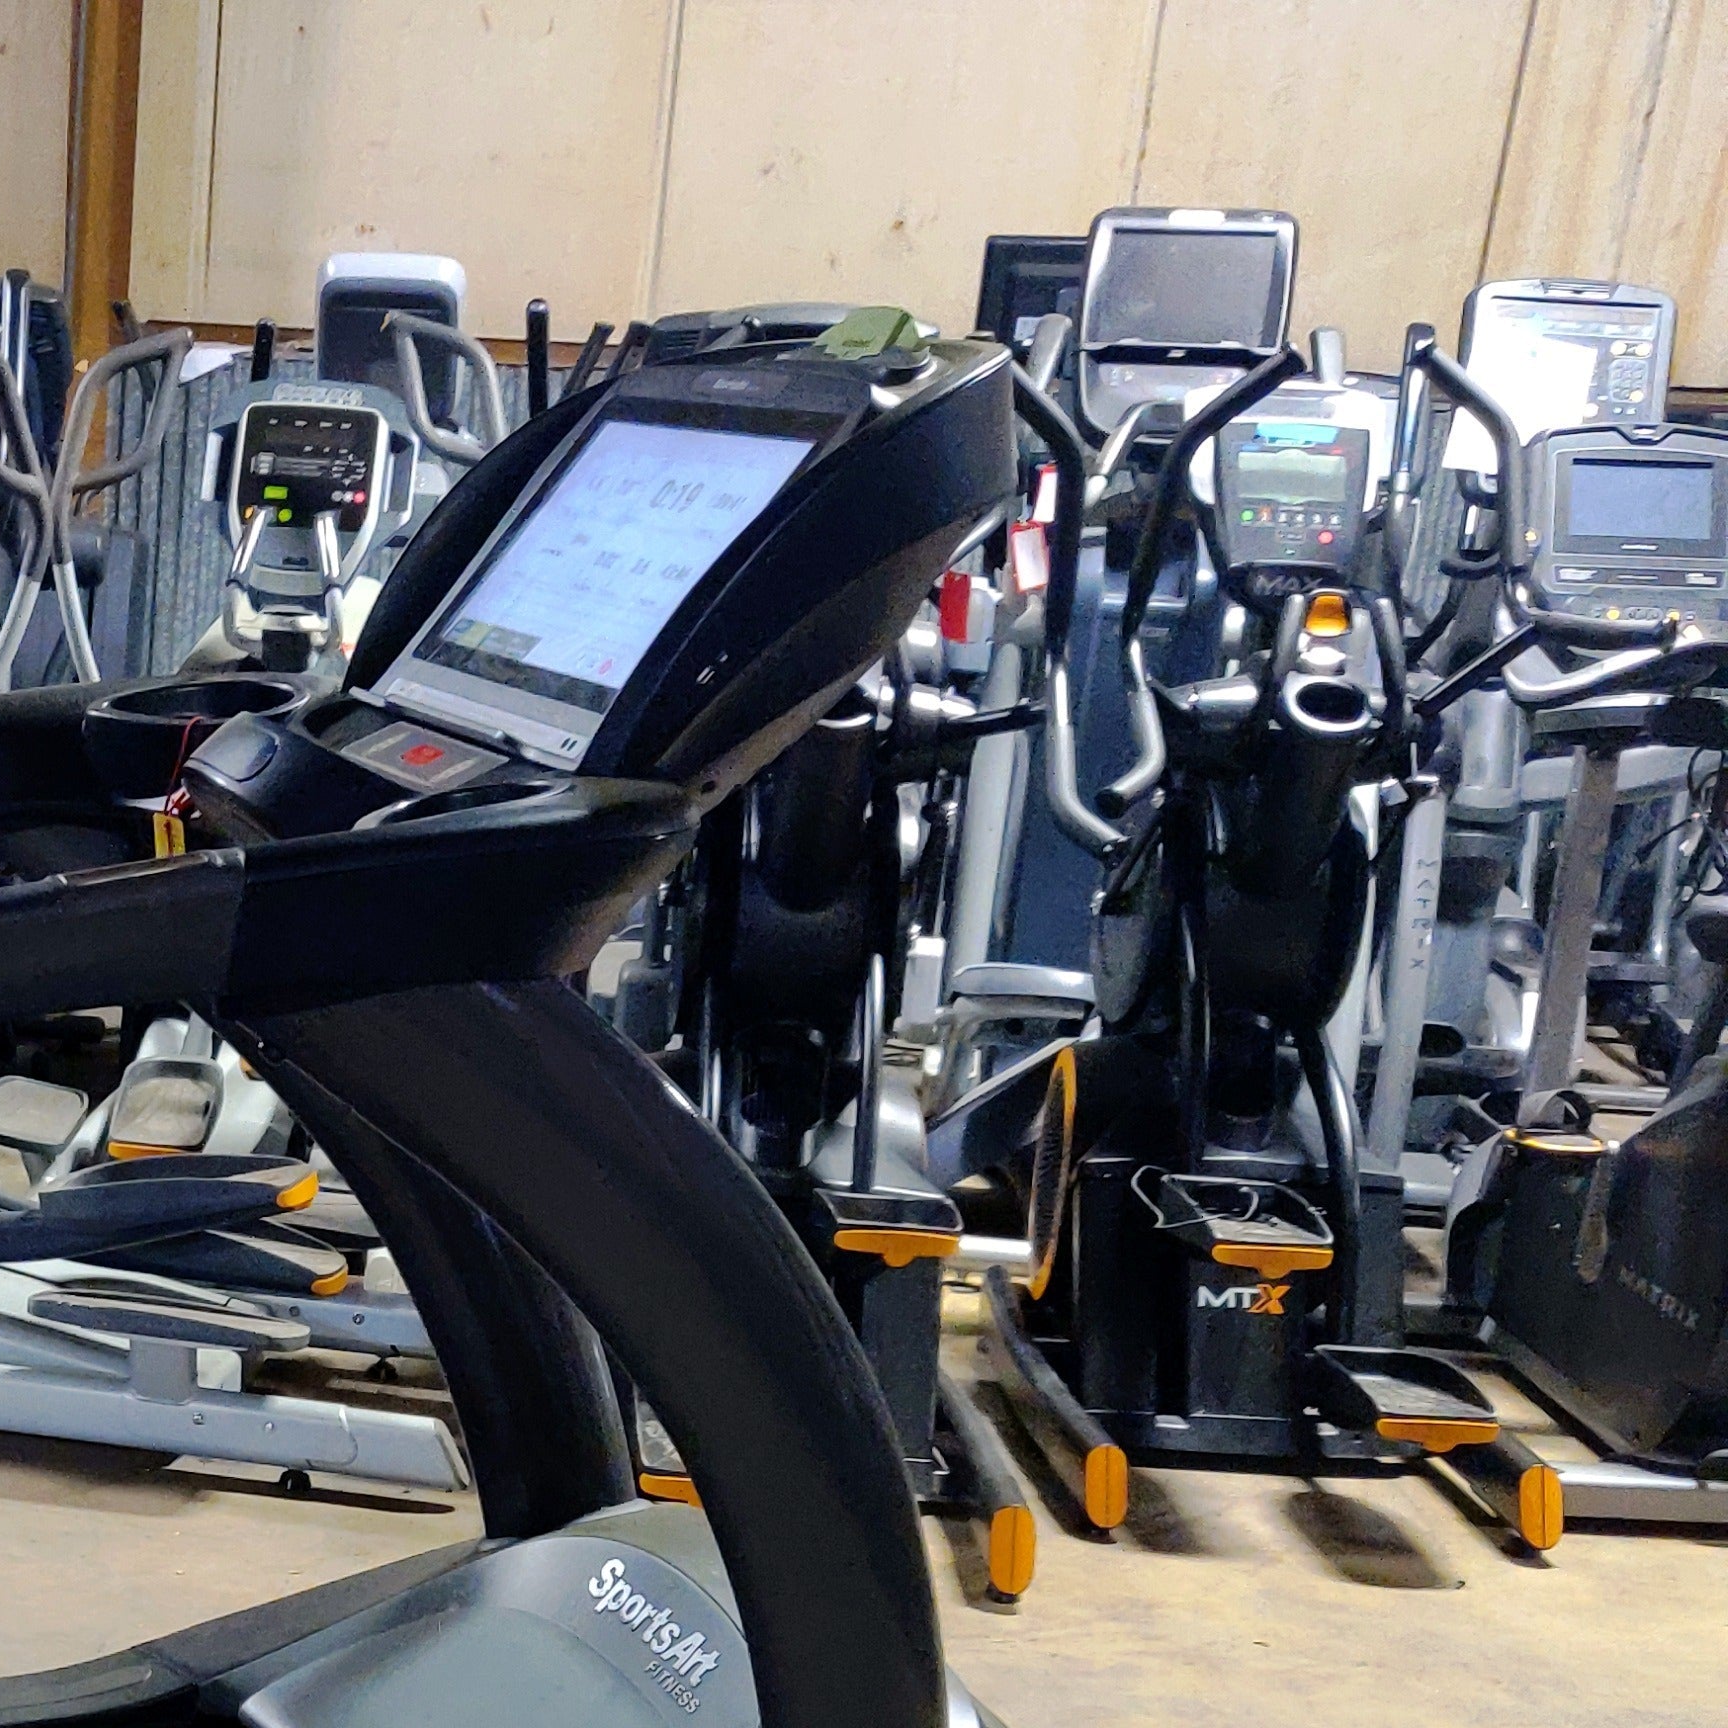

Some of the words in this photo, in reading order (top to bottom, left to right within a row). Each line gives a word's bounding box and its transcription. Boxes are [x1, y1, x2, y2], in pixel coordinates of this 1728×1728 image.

[1409, 858, 1438, 969] MATRIX
[1197, 1284, 1291, 1315] MTX
[588, 1558, 722, 1688] SportsArt
[644, 1660, 701, 1714] FITNESS
